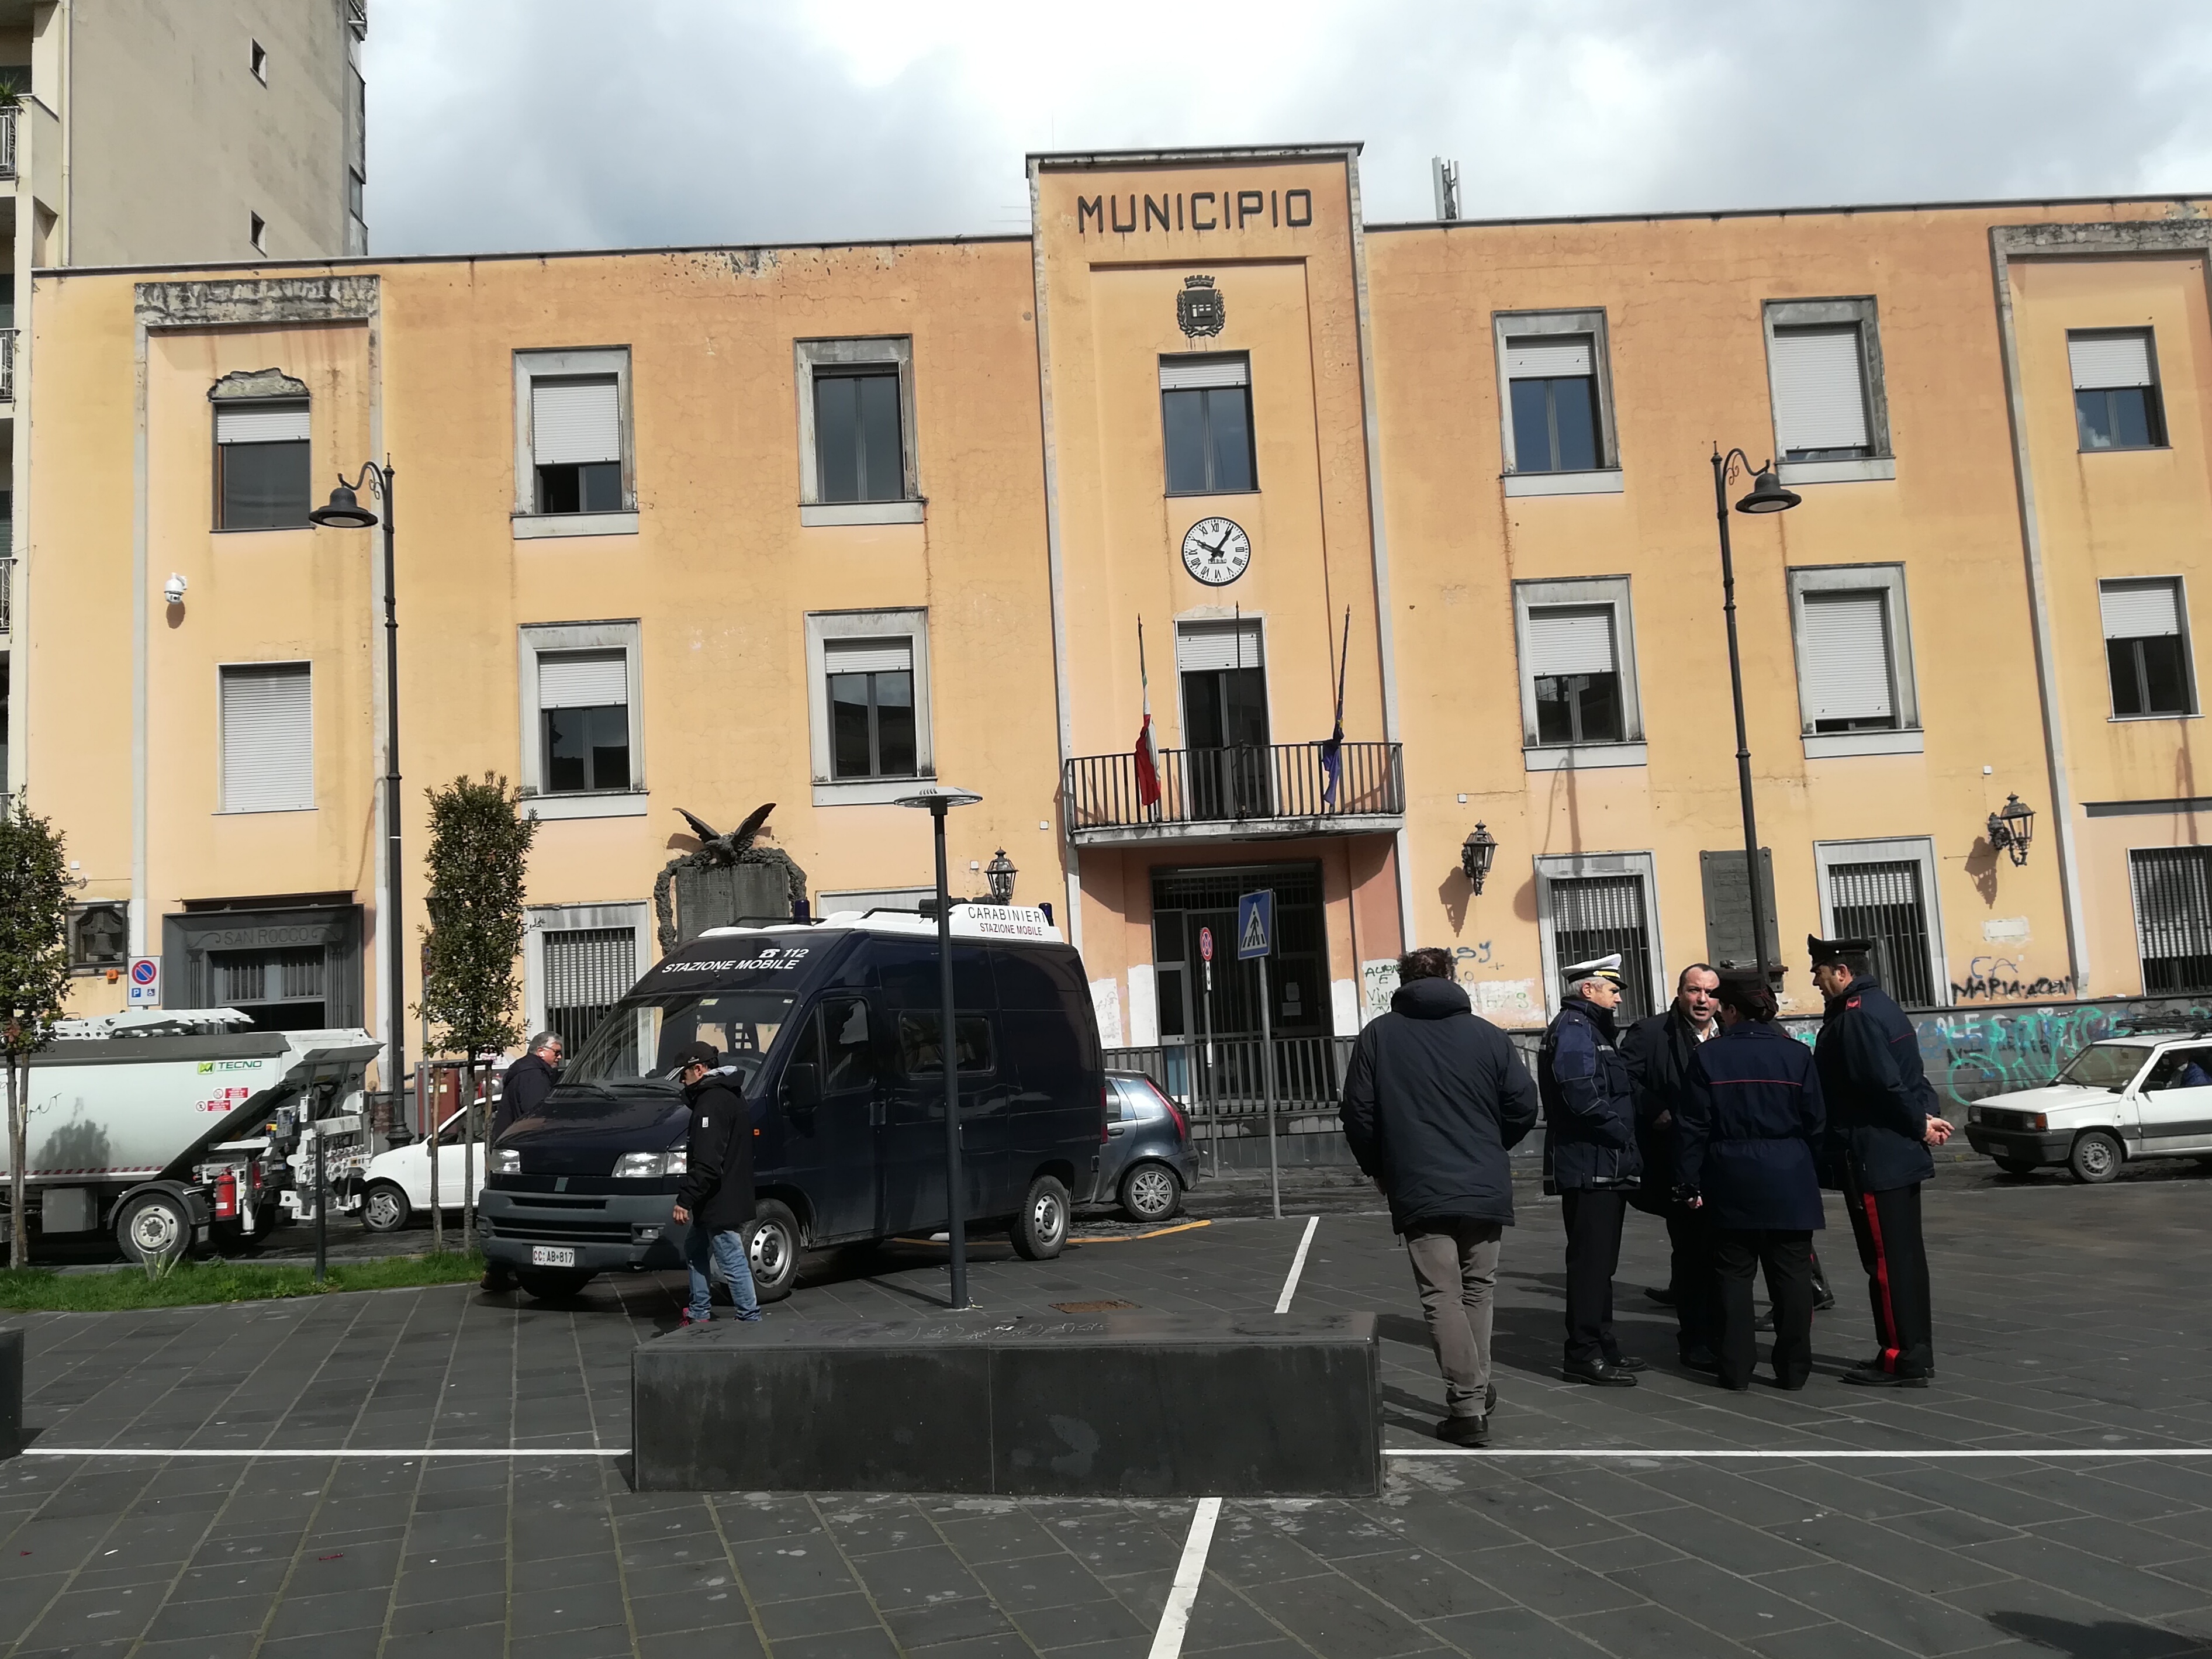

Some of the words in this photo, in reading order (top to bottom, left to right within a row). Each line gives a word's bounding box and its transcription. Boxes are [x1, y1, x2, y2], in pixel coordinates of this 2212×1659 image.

[1077, 188, 1313, 233] MUNICIPIO
[967, 906, 1046, 923] CARABINIERI
[224, 929, 254, 945] SAN
[258, 927, 309, 943] ROCCO
[980, 922, 1015, 934] STAZIONE
[1016, 925, 1043, 936] MOBILE
[783, 948, 810, 958] 112
[662, 960, 737, 973] STAZIONE
[734, 959, 800, 970] MOBILE
[217, 1060, 262, 1069] TECNO
